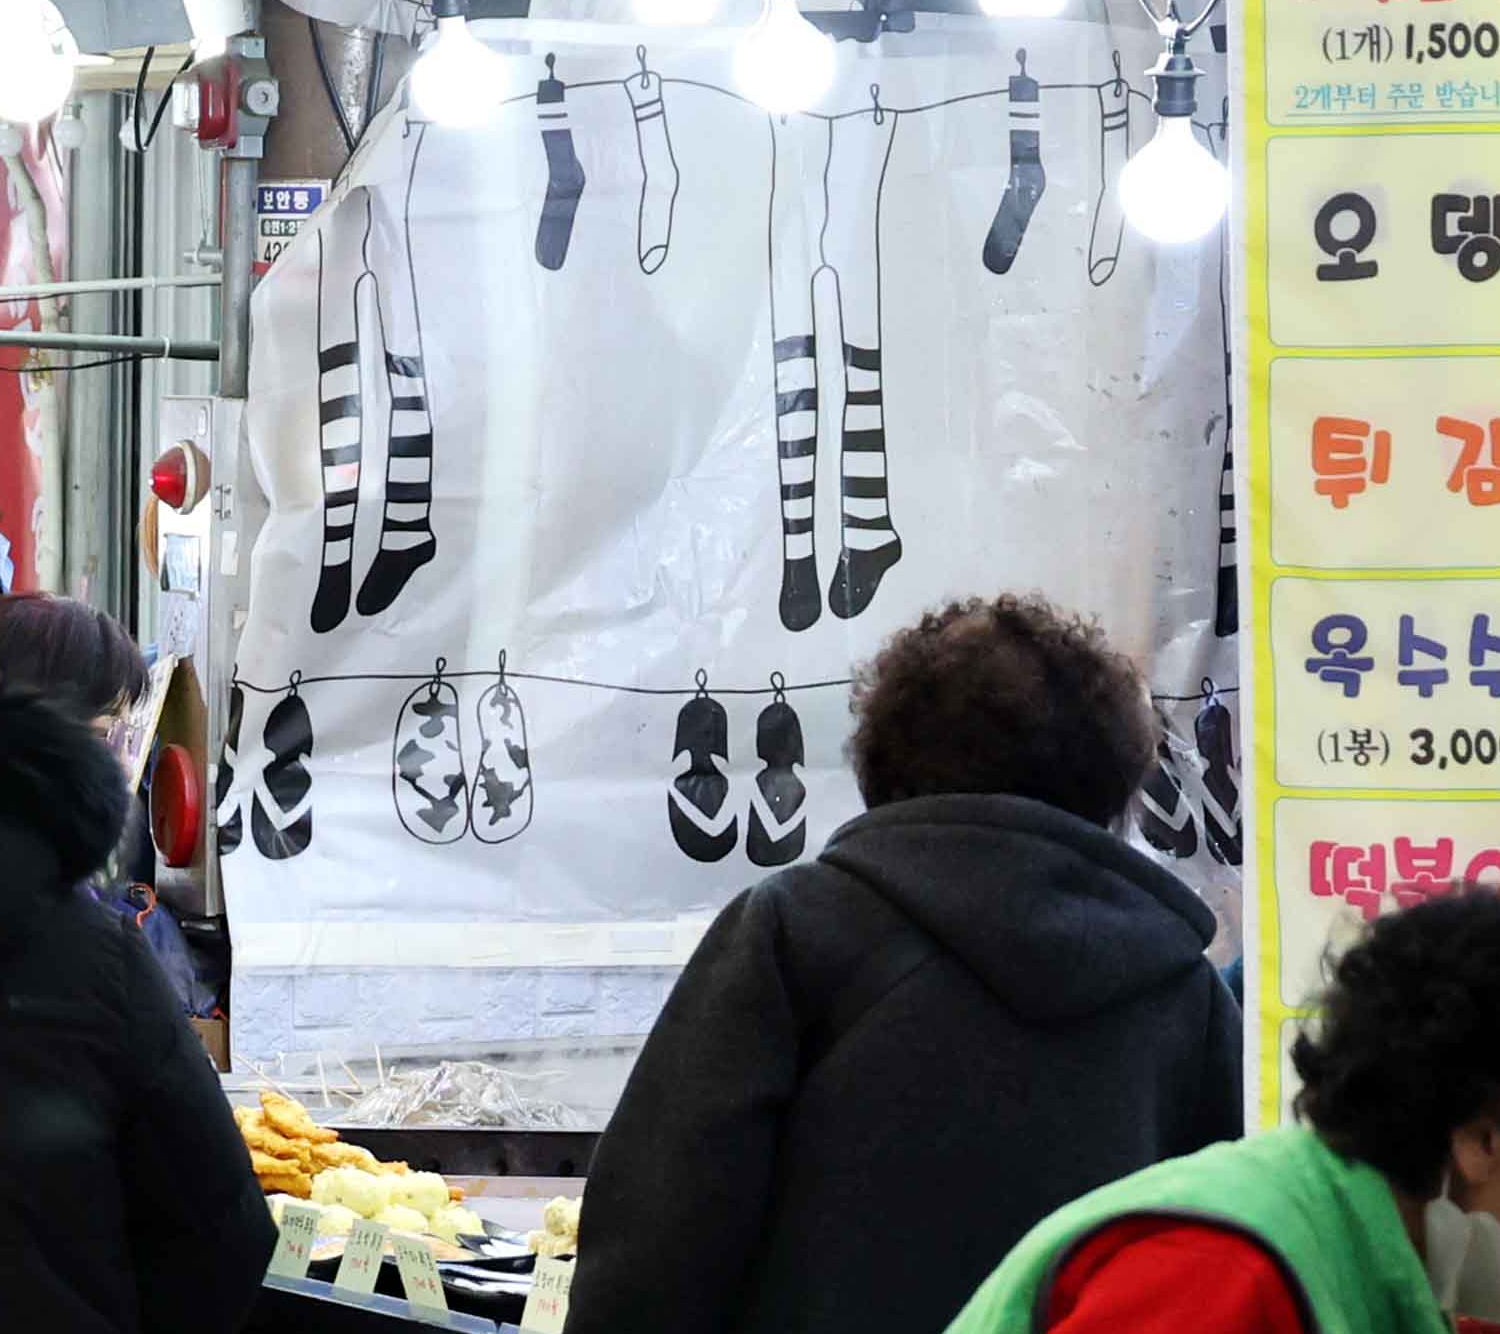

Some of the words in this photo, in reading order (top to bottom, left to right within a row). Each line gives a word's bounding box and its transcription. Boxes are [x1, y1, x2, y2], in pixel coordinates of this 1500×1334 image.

[1321, 23, 1394, 65] (1개)
[1404, 22, 1500, 65] 1,500
[1295, 81, 1377, 110] 2개부터
[1386, 81, 1426, 109] 주문
[263, 190, 310, 210] 보안등
[263, 241, 290, 264] 42
[1317, 728, 1391, 766] (1봉)
